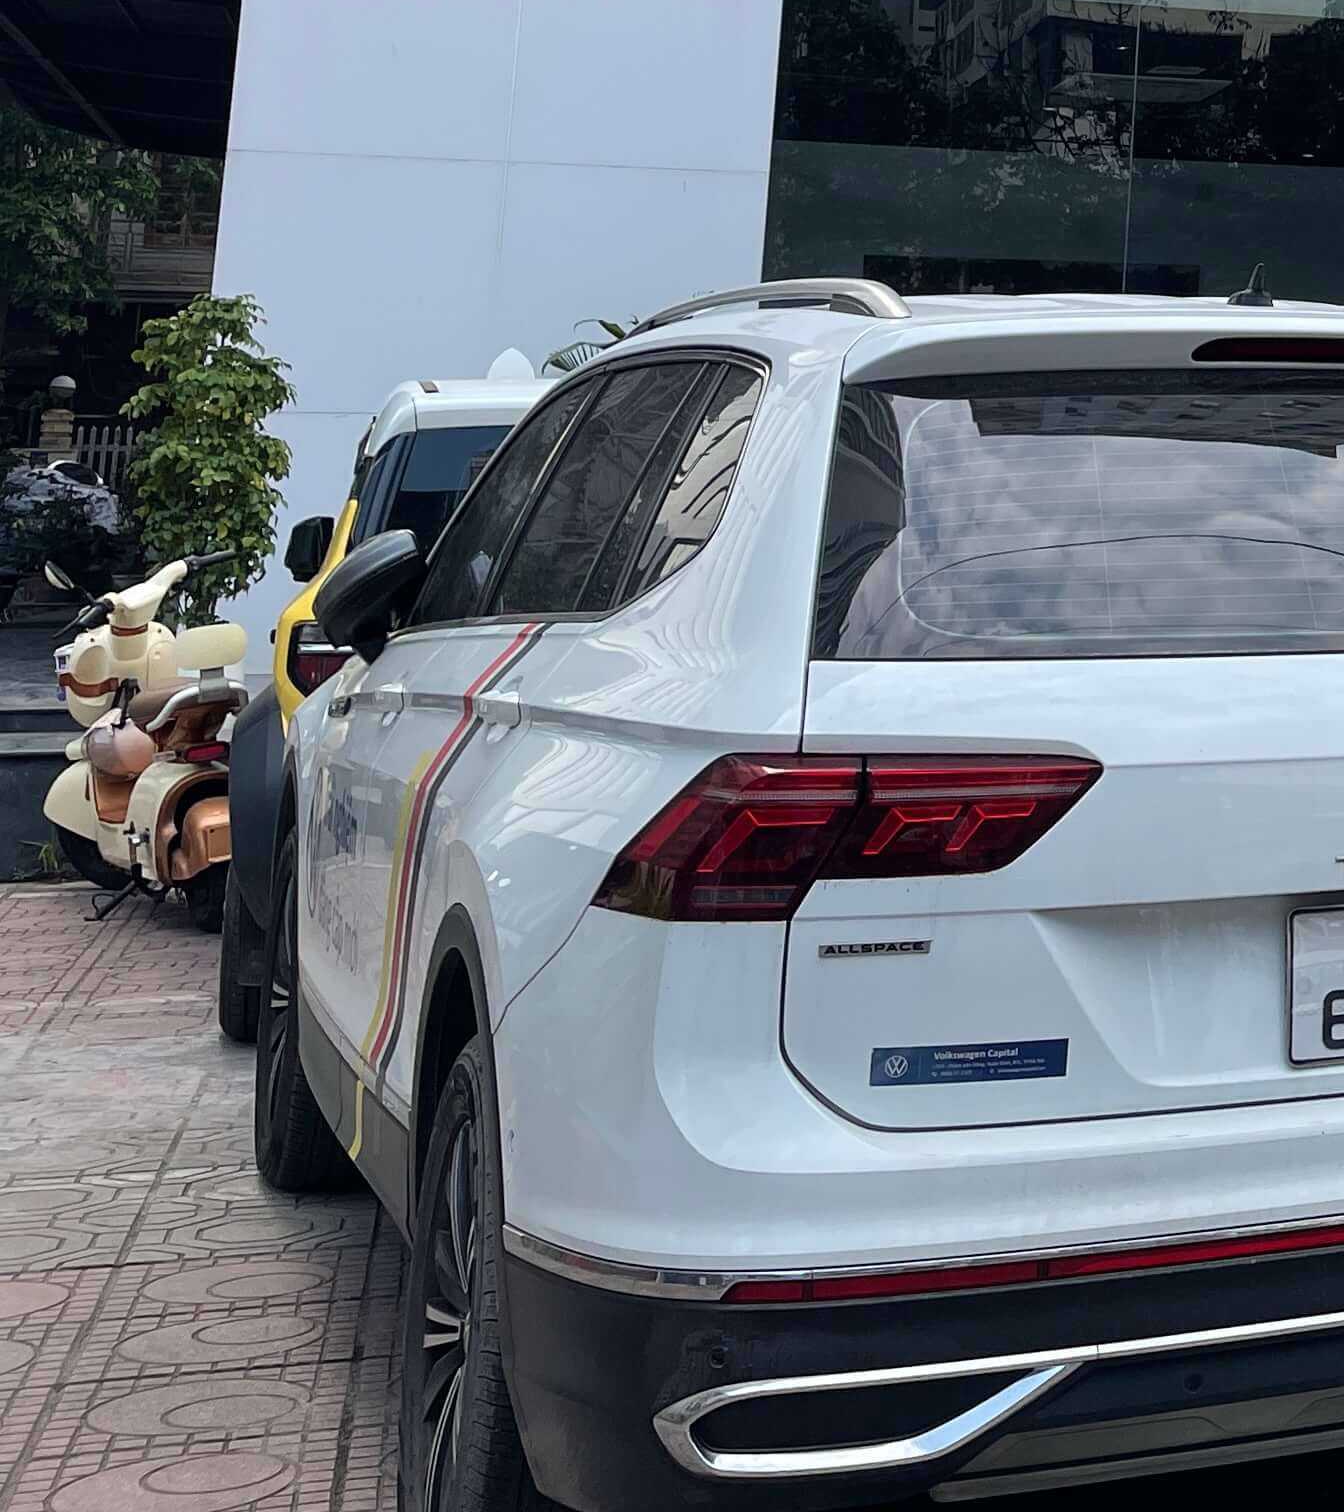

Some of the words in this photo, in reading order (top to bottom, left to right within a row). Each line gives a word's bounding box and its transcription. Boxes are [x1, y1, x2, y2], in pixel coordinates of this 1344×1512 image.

[822, 942, 926, 955] ALLSPACE
[933, 1049, 986, 1061] Volkswagen
[987, 1047, 1018, 1058] Capital
